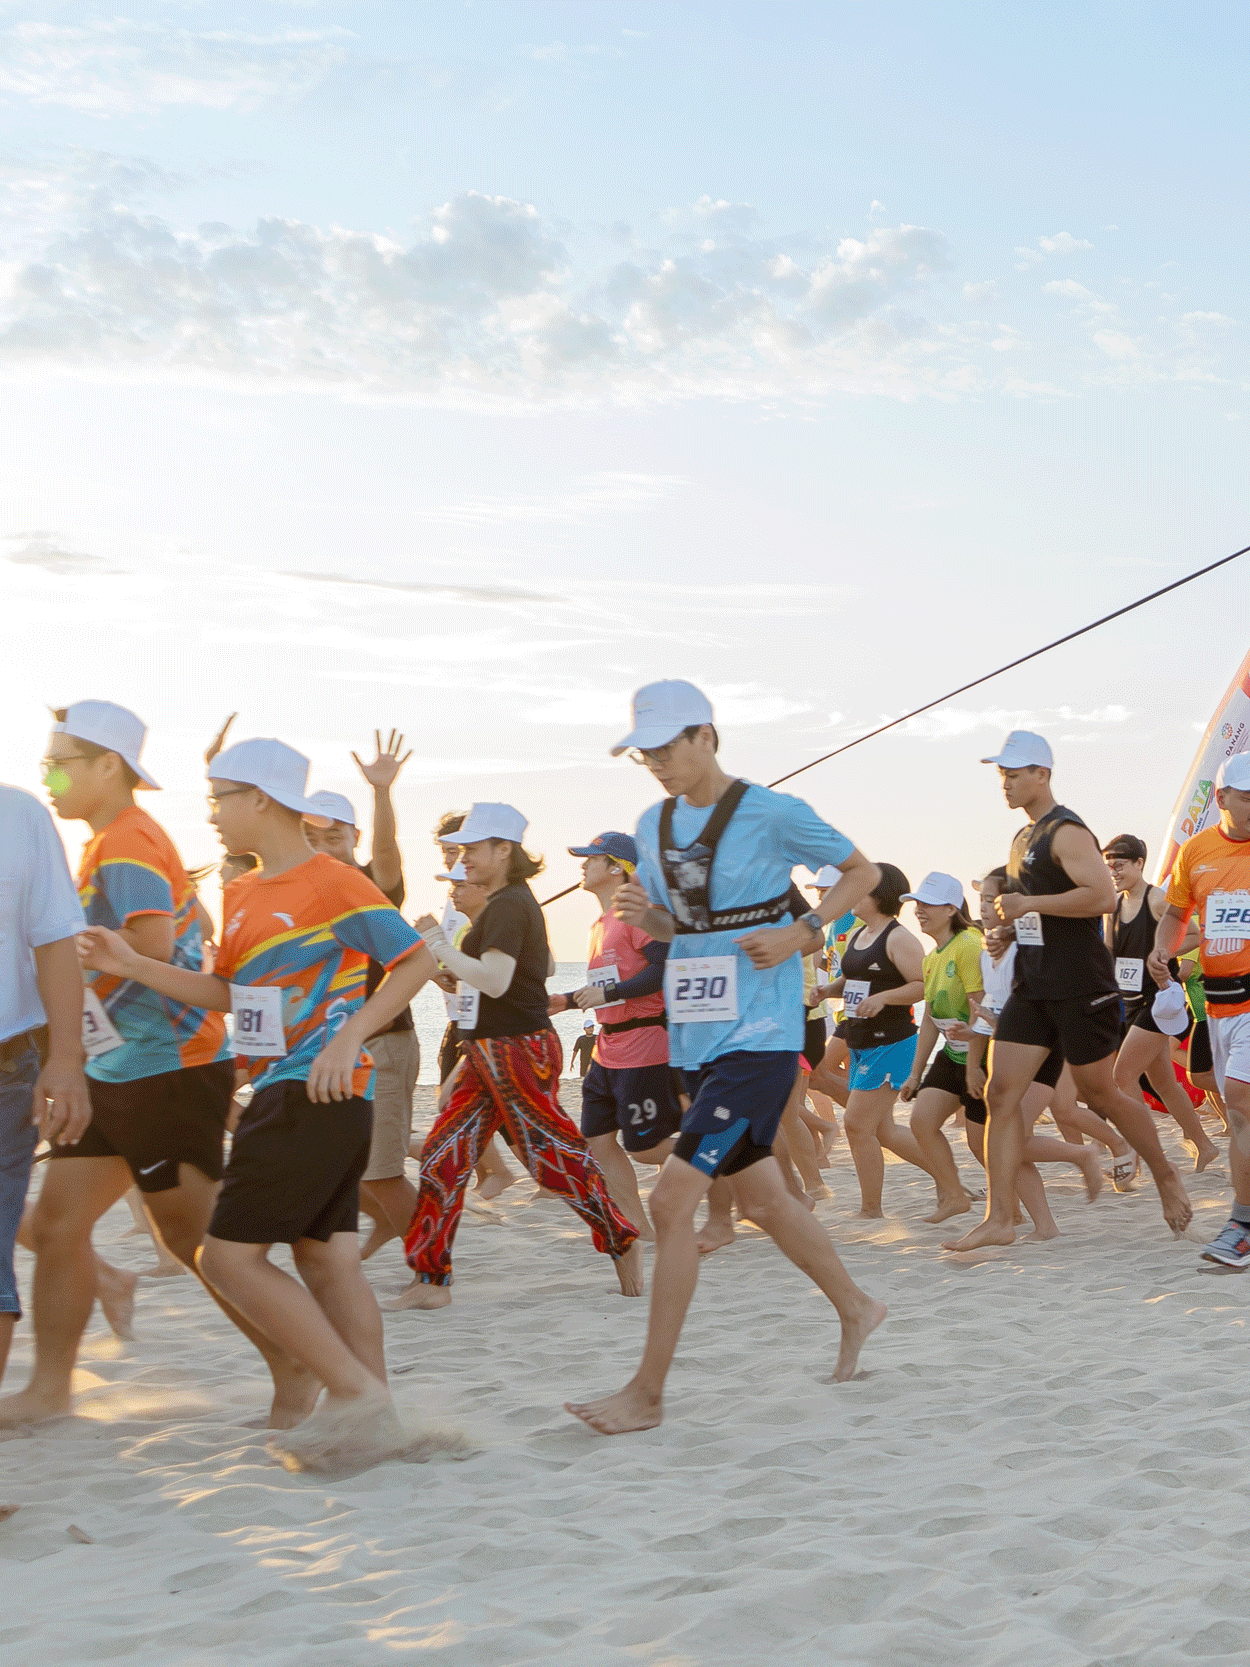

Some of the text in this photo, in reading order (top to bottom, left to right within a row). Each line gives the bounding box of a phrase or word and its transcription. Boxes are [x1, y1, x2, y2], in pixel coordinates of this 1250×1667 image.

[1119, 968, 1138, 980] 167
[676, 976, 727, 1000] 230
[628, 1098, 658, 1125] 29
